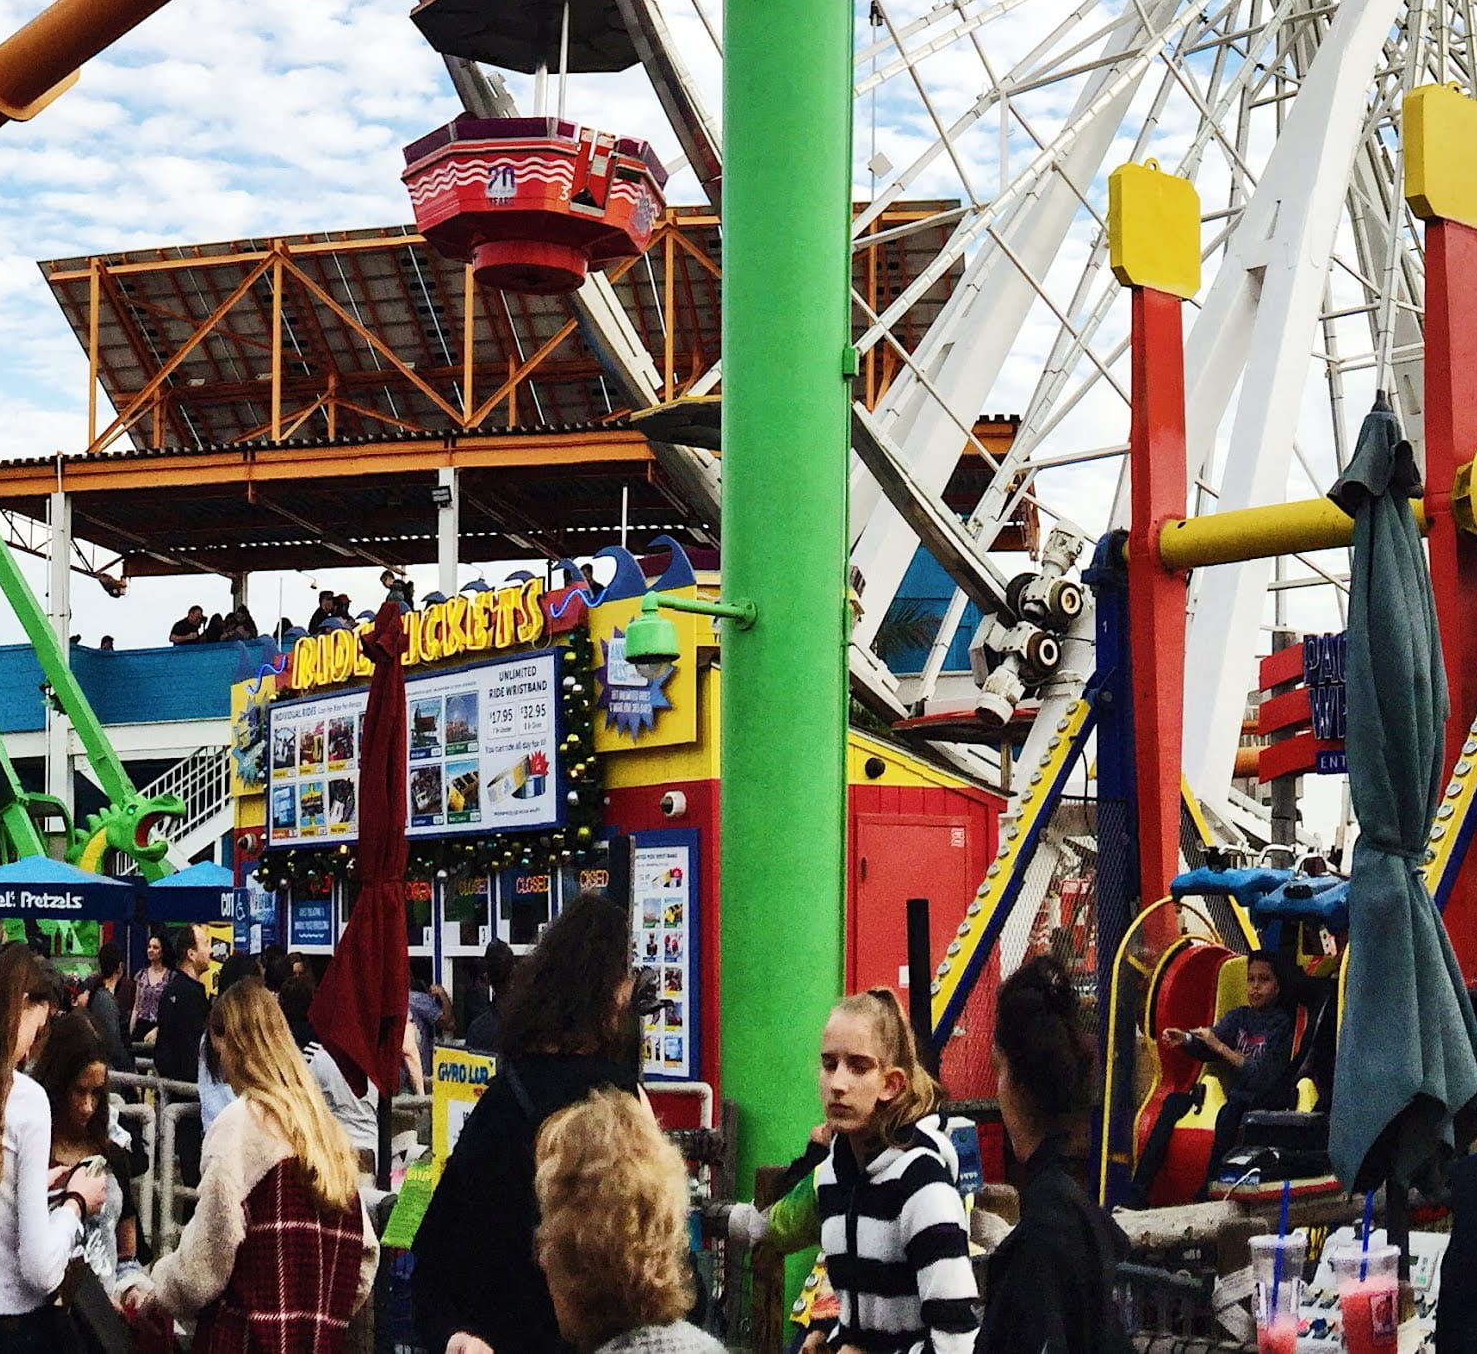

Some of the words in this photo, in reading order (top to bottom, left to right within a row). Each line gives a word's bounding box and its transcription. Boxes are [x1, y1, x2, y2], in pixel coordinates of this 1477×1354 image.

[487, 166, 516, 196] 20
[559, 185, 570, 201] 3
[291, 622, 375, 690] RIDE
[399, 576, 545, 667] ICKETS
[499, 665, 537, 682] UNLIMITED
[489, 686, 505, 699] RIDE
[506, 680, 548, 696] WRISTBAND
[489, 708, 514, 724] $17.95
[520, 703, 547, 719] $32.95
[516, 874, 550, 895] CLOSED
[20, 891, 83, 909] Pretzels
[437, 1061, 467, 1084] GYRO
